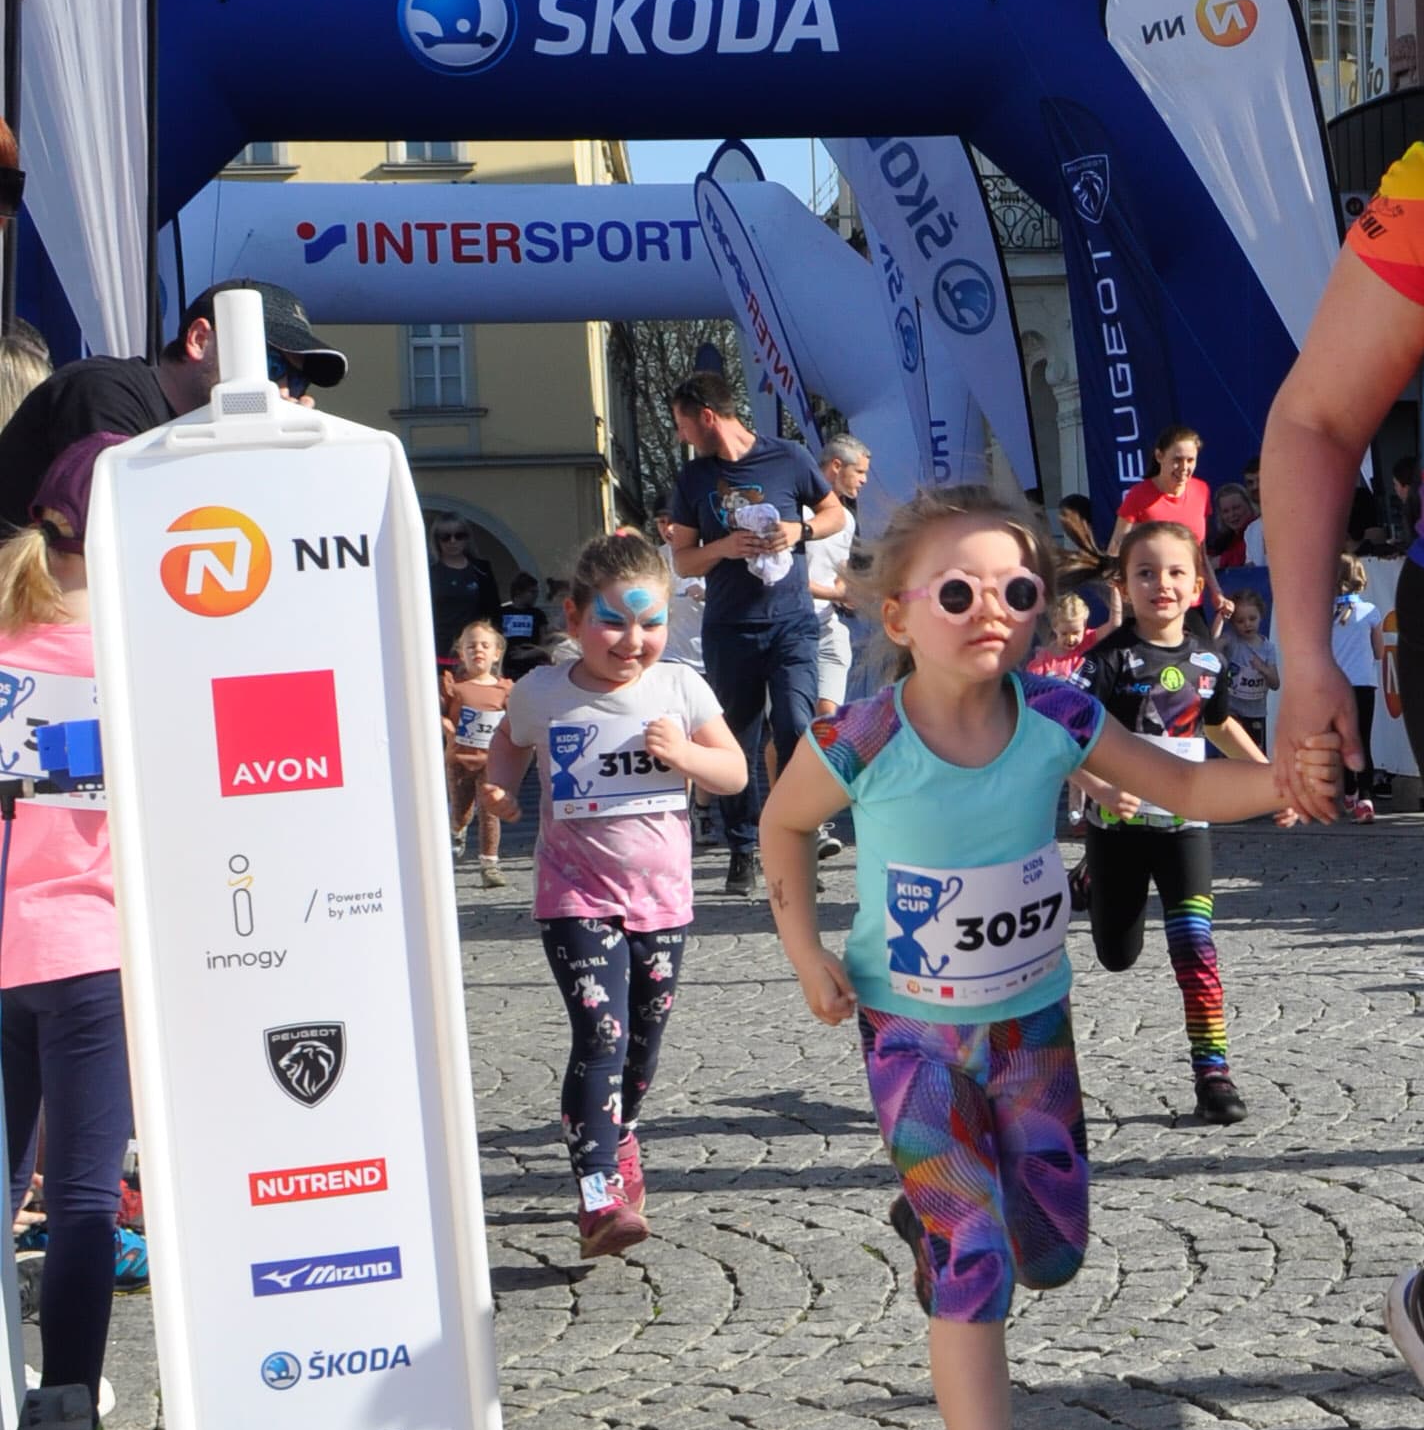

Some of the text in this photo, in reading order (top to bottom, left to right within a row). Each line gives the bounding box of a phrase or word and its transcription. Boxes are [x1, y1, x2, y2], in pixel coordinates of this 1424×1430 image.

[356, 219, 701, 265] INTERSPORT
[292, 533, 371, 573] NN
[555, 733, 581, 744] KIDS
[556, 744, 579, 754] CUP
[232, 757, 328, 787] AVON
[1022, 856, 1045, 873] KIDS
[1022, 870, 1043, 885] CUP
[326, 887, 384, 905] Powered
[896, 883, 933, 899] KIDS
[328, 902, 384, 920] by MVM
[896, 898, 930, 913] CUP
[954, 892, 1063, 951] 3057
[206, 946, 288, 971] innogy
[271, 1027, 339, 1044] PEUGEOT
[256, 1166, 382, 1199] NUTREND
[308, 1345, 411, 1380] ŠKODA
